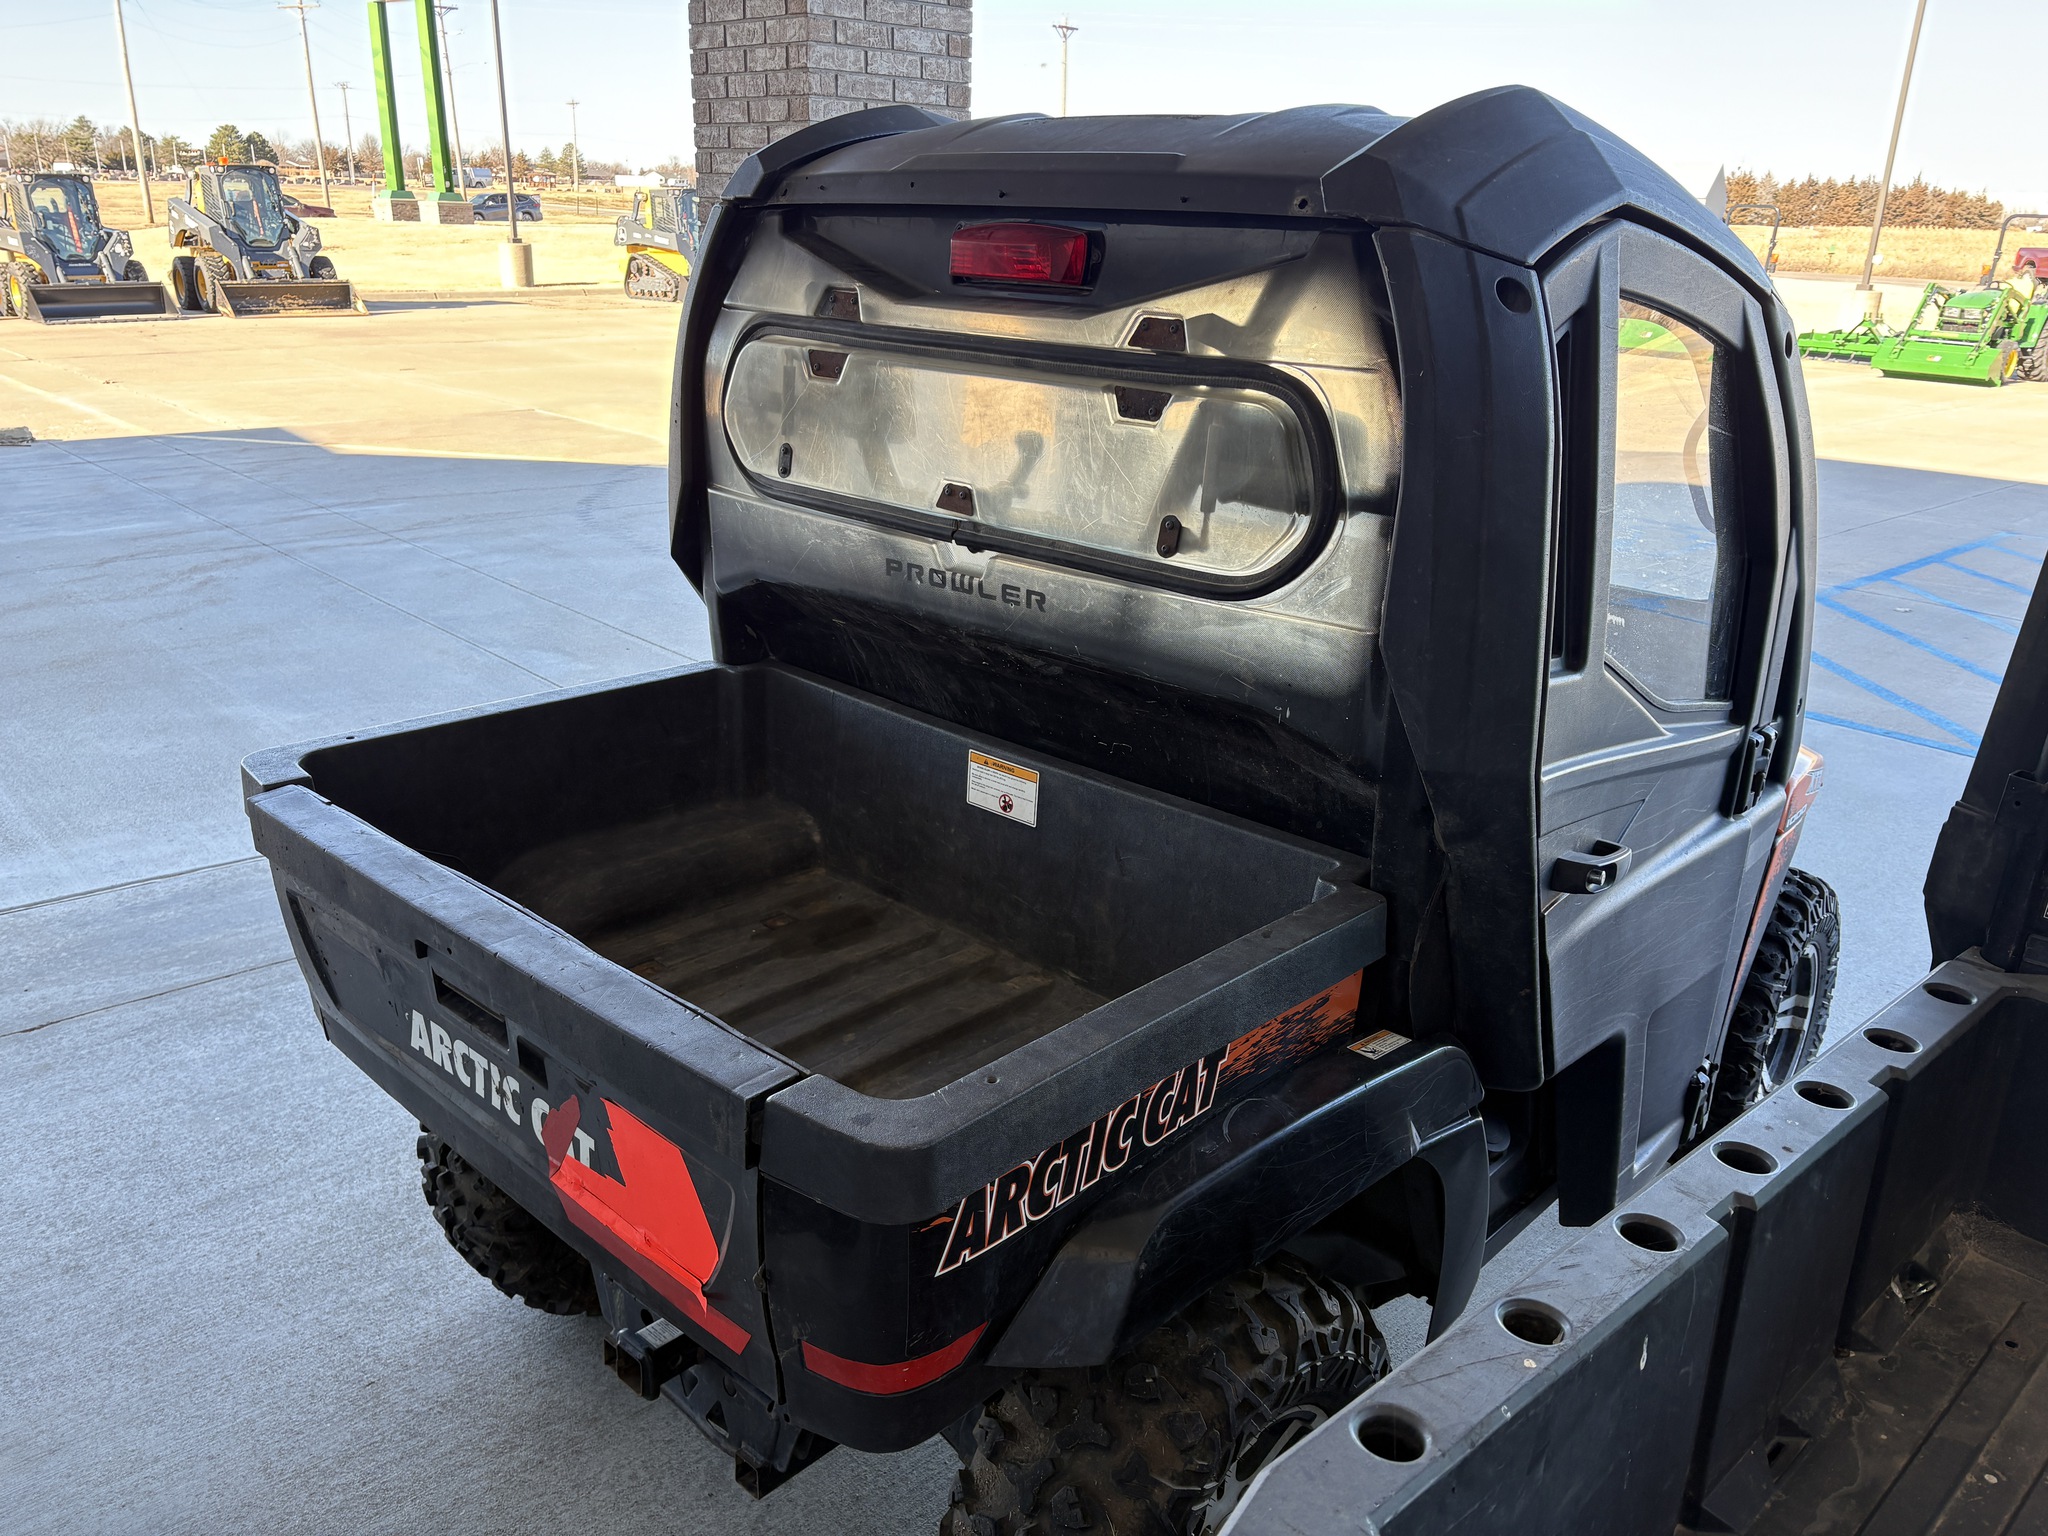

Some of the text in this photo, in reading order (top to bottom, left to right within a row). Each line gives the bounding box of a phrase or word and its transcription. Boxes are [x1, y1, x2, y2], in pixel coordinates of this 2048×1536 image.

[885, 557, 1047, 613] PROWLER
[410, 1008, 595, 1170] ARCTIC CT
[933, 1043, 1231, 1278] ARCTIC CAT
